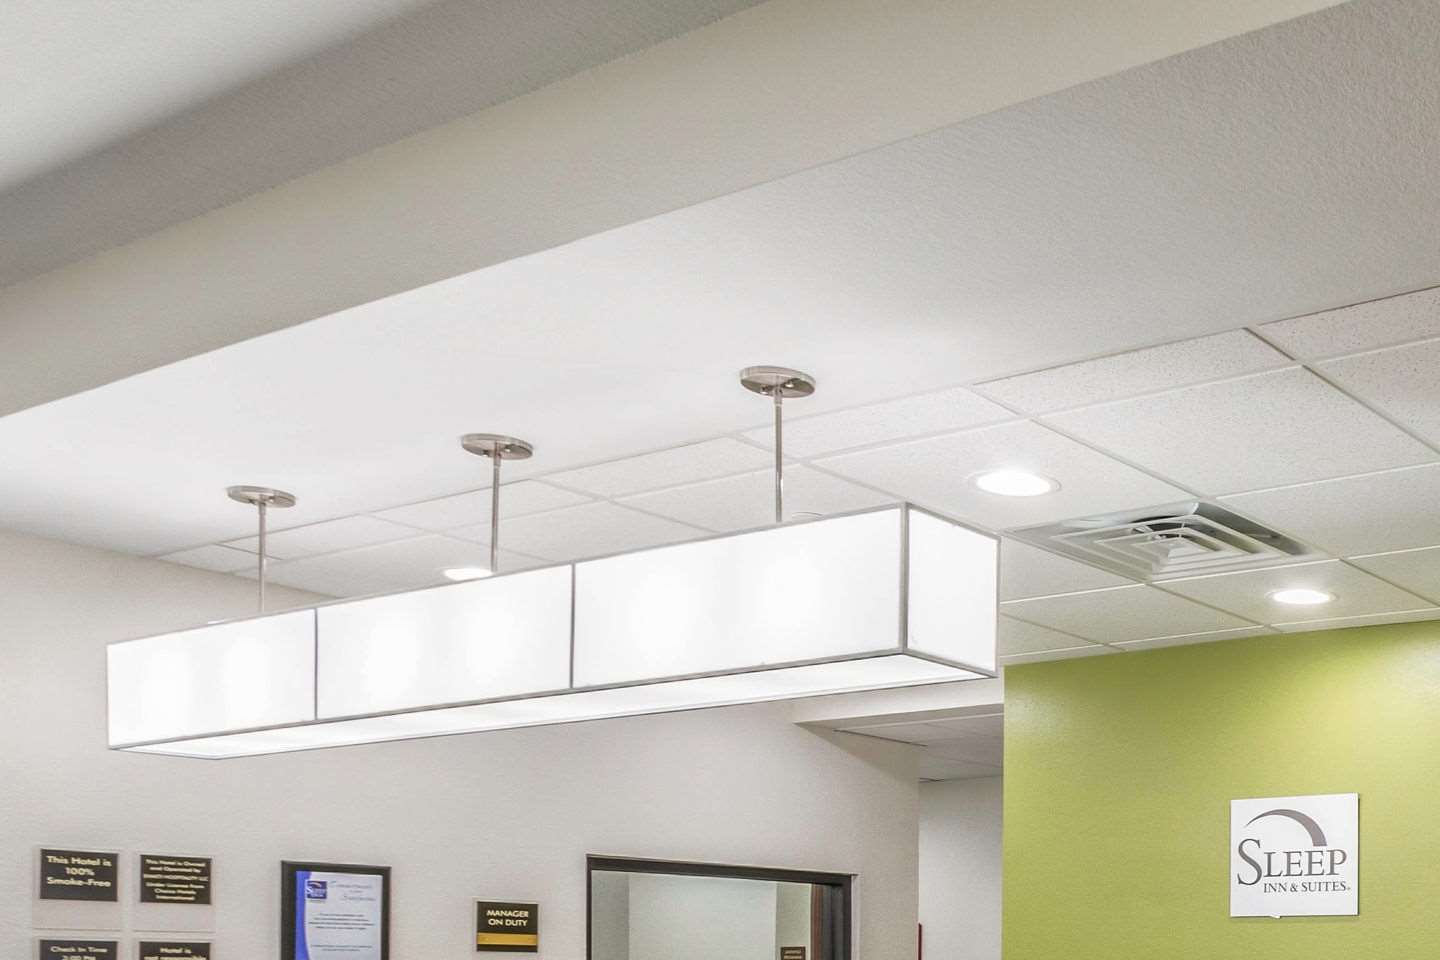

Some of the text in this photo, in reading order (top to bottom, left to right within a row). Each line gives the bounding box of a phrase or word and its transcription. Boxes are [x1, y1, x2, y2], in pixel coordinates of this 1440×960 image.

[46, 855, 112, 867] This Hotel is
[1237, 838, 1347, 885] SLEEP
[65, 867, 95, 876] 100%
[46, 876, 112, 888] Smoke-Free
[1263, 881, 1347, 893] INN & SUITES
[486, 909, 529, 918] MANAGER
[487, 918, 528, 927] ON DUTY
[50, 945, 76, 953] Check
